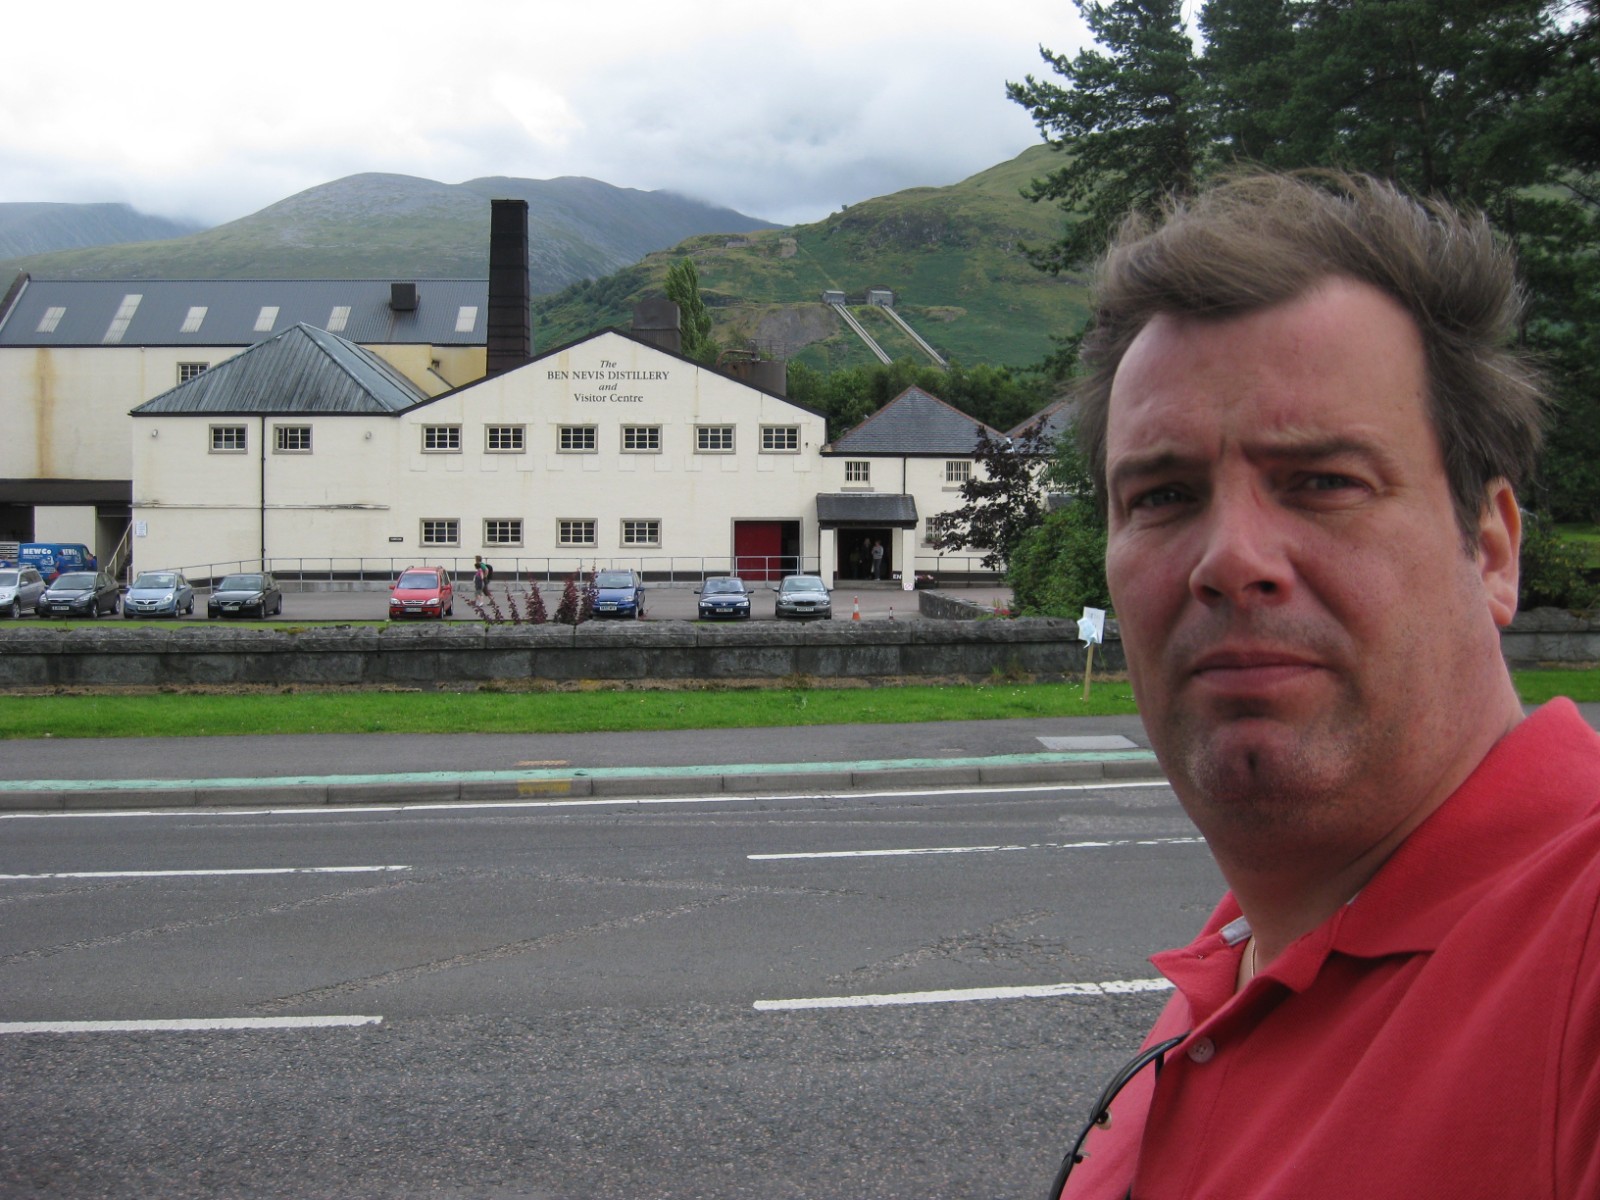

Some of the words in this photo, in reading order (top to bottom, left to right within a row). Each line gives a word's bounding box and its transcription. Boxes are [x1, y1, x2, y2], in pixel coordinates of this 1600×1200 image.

[600, 360, 617, 368] The
[547, 371, 569, 380] BEN
[572, 371, 605, 380] NEVIS
[608, 371, 670, 380] DISTILLERY
[598, 383, 618, 391] and
[574, 393, 607, 402] Visitor
[609, 393, 643, 402] Centre
